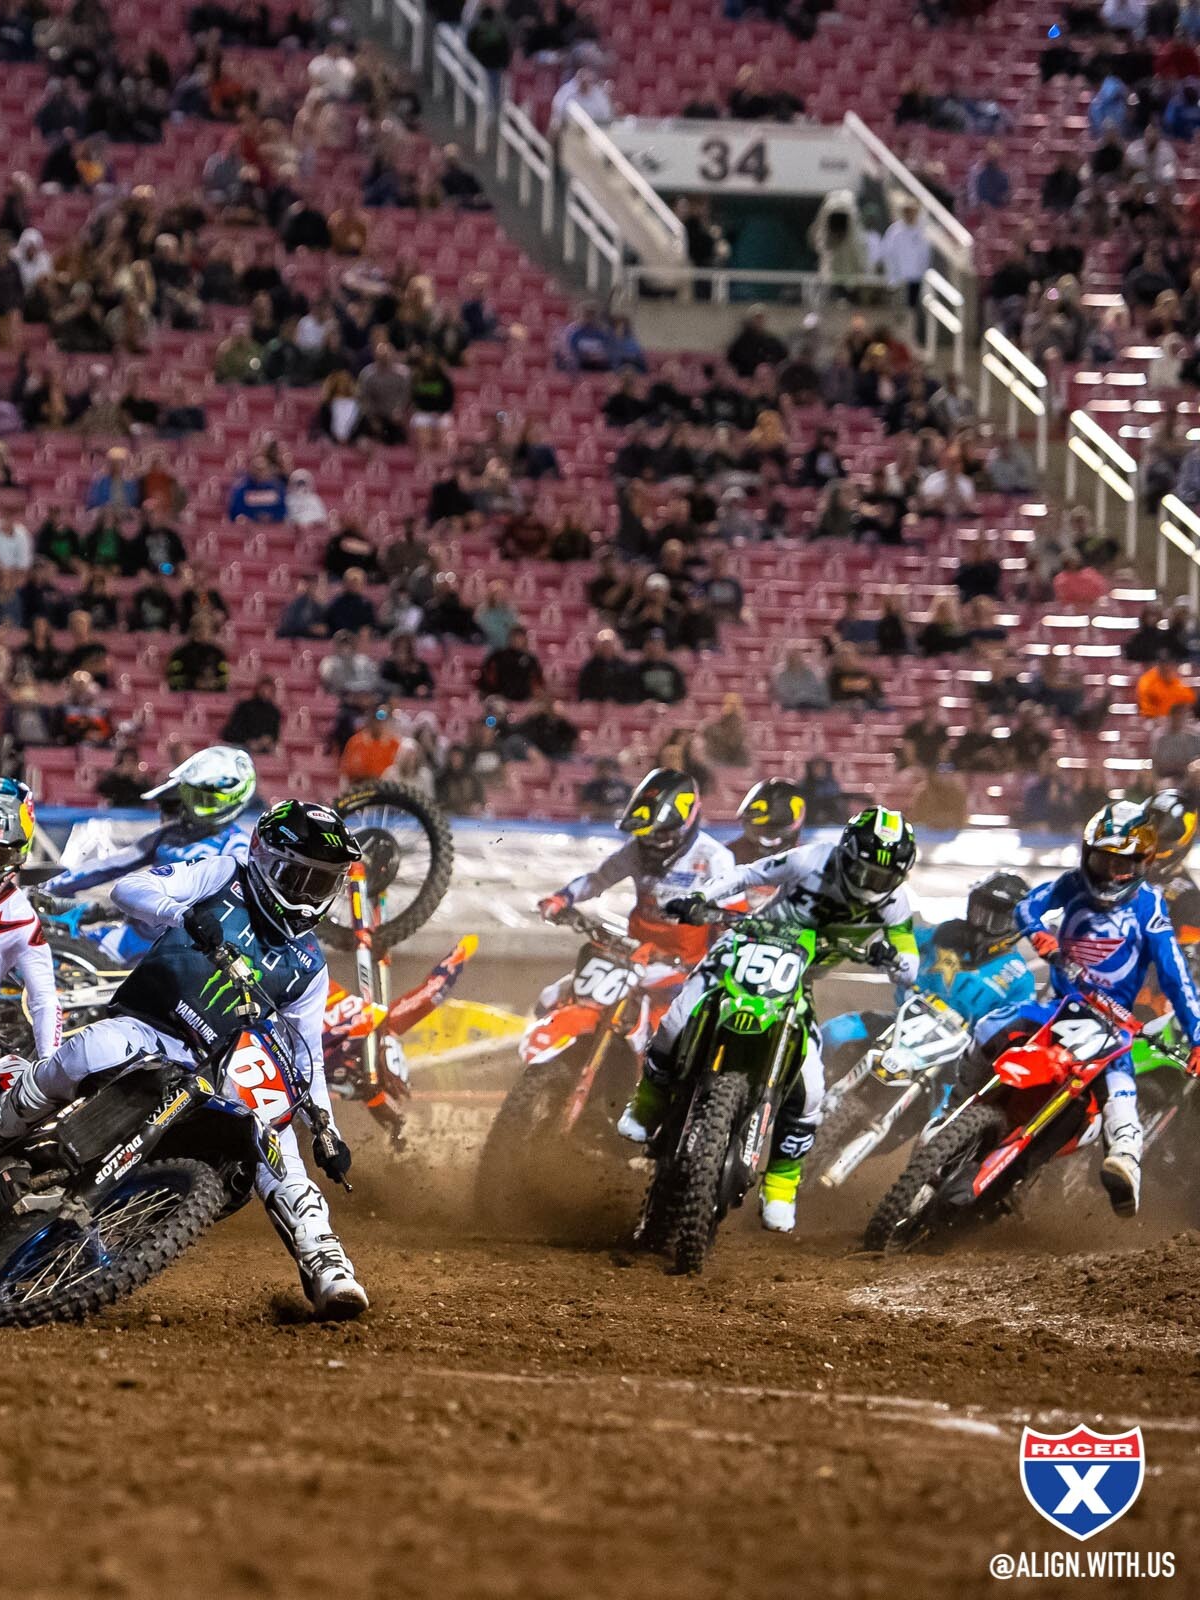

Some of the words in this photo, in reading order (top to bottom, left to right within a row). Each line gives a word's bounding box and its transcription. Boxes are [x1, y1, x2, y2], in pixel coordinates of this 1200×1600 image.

[699, 138, 771, 183] 34
[311, 811, 331, 820] BELL
[574, 957, 629, 1005] 56
[734, 943, 800, 993] 150
[174, 1000, 218, 1045] YAMALUBE
[227, 1045, 291, 1126] 64
[276, 1050, 294, 1084] MONSTER
[95, 1134, 144, 1185] DUNLOP
